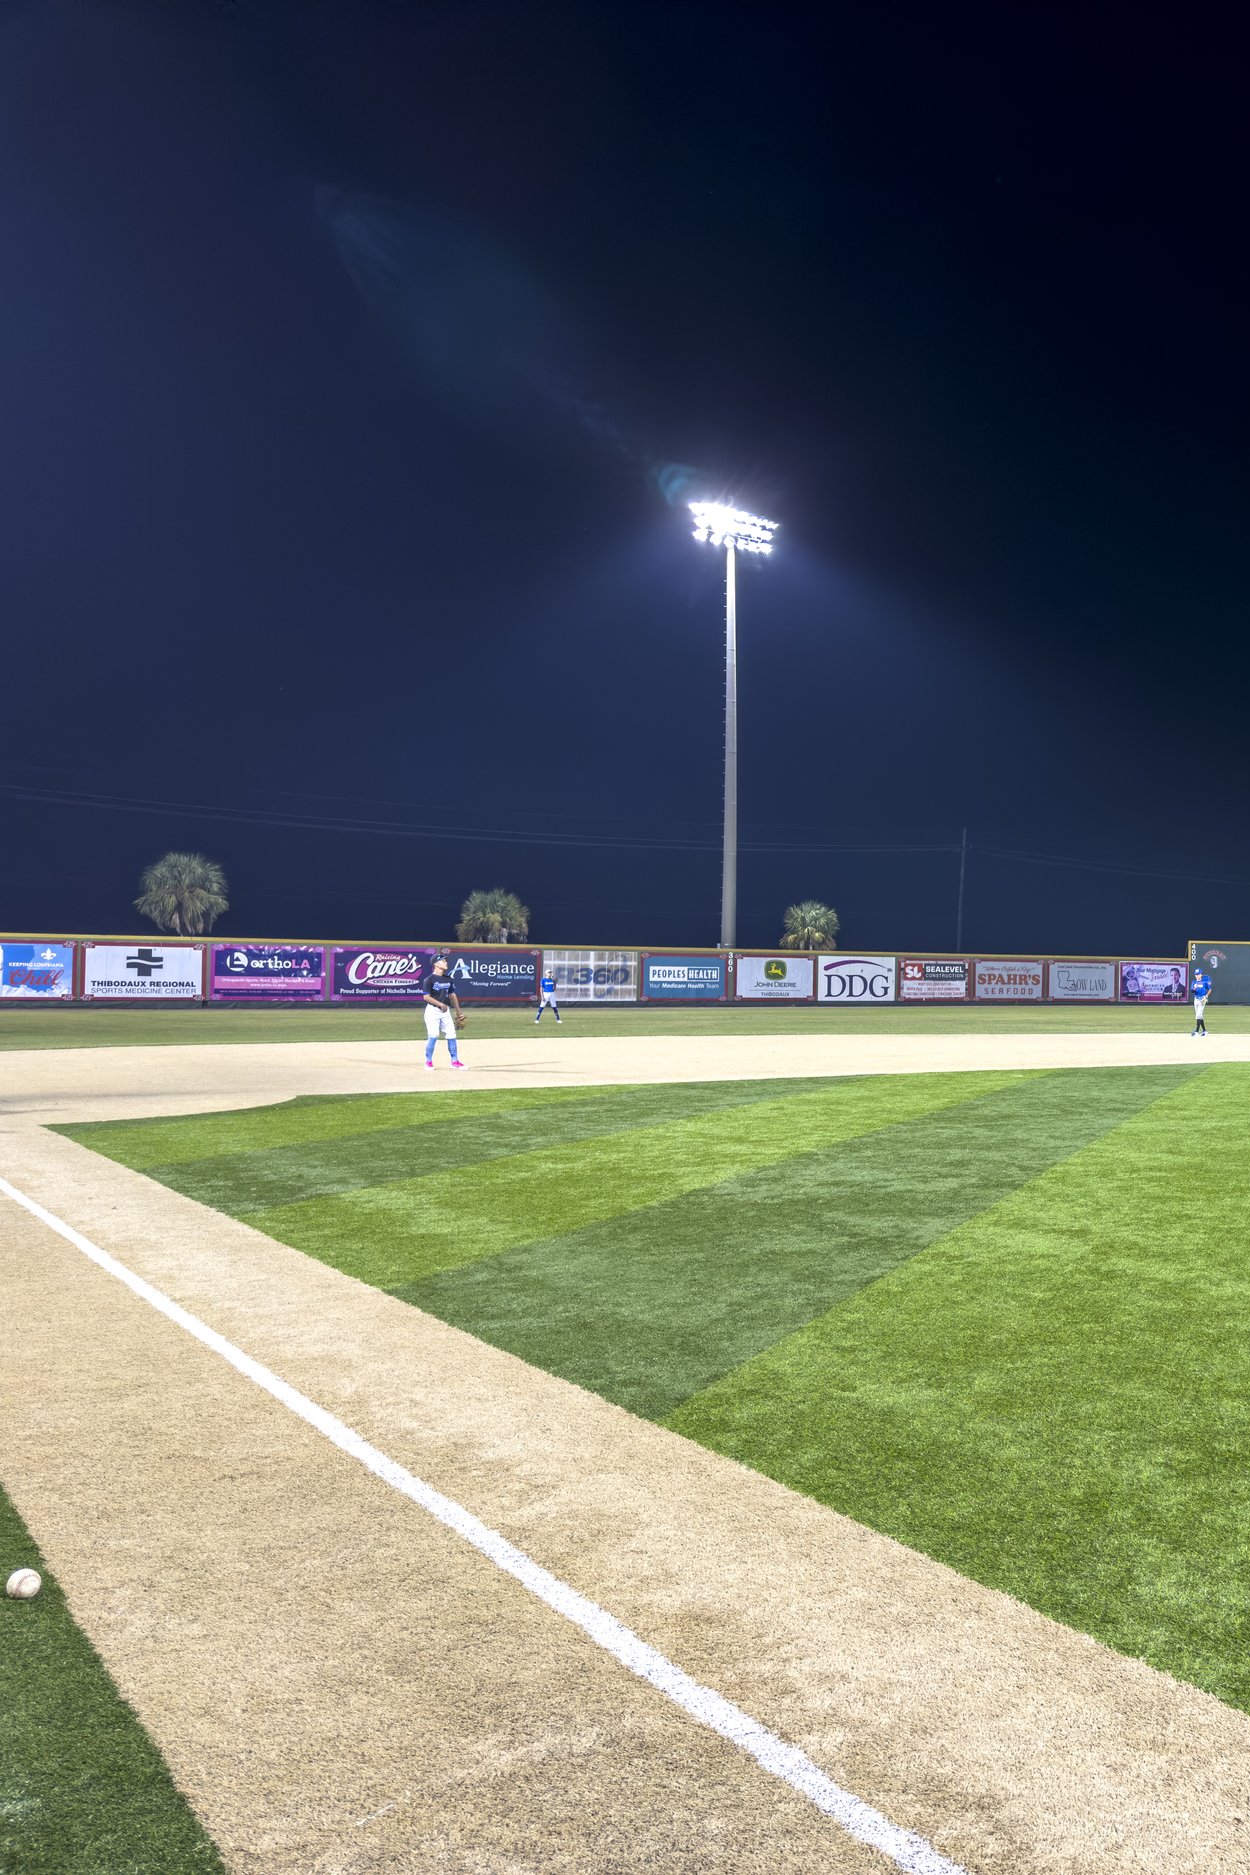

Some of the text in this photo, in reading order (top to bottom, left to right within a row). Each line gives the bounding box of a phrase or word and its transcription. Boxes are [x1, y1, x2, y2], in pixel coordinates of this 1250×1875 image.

[250, 956, 311, 969] orthoLA
[348, 952, 422, 985] Cane's
[449, 958, 535, 978] Allegiance
[9, 969, 65, 986] Chill
[652, 969, 718, 979] PEOPLES HEALTH
[905, 965, 922, 979] SL
[824, 974, 890, 998] DDG
[977, 973, 1041, 986] SPAHR'S
[1090, 979, 1107, 991] LAND
[984, 987, 1034, 995] SEAFOOD
